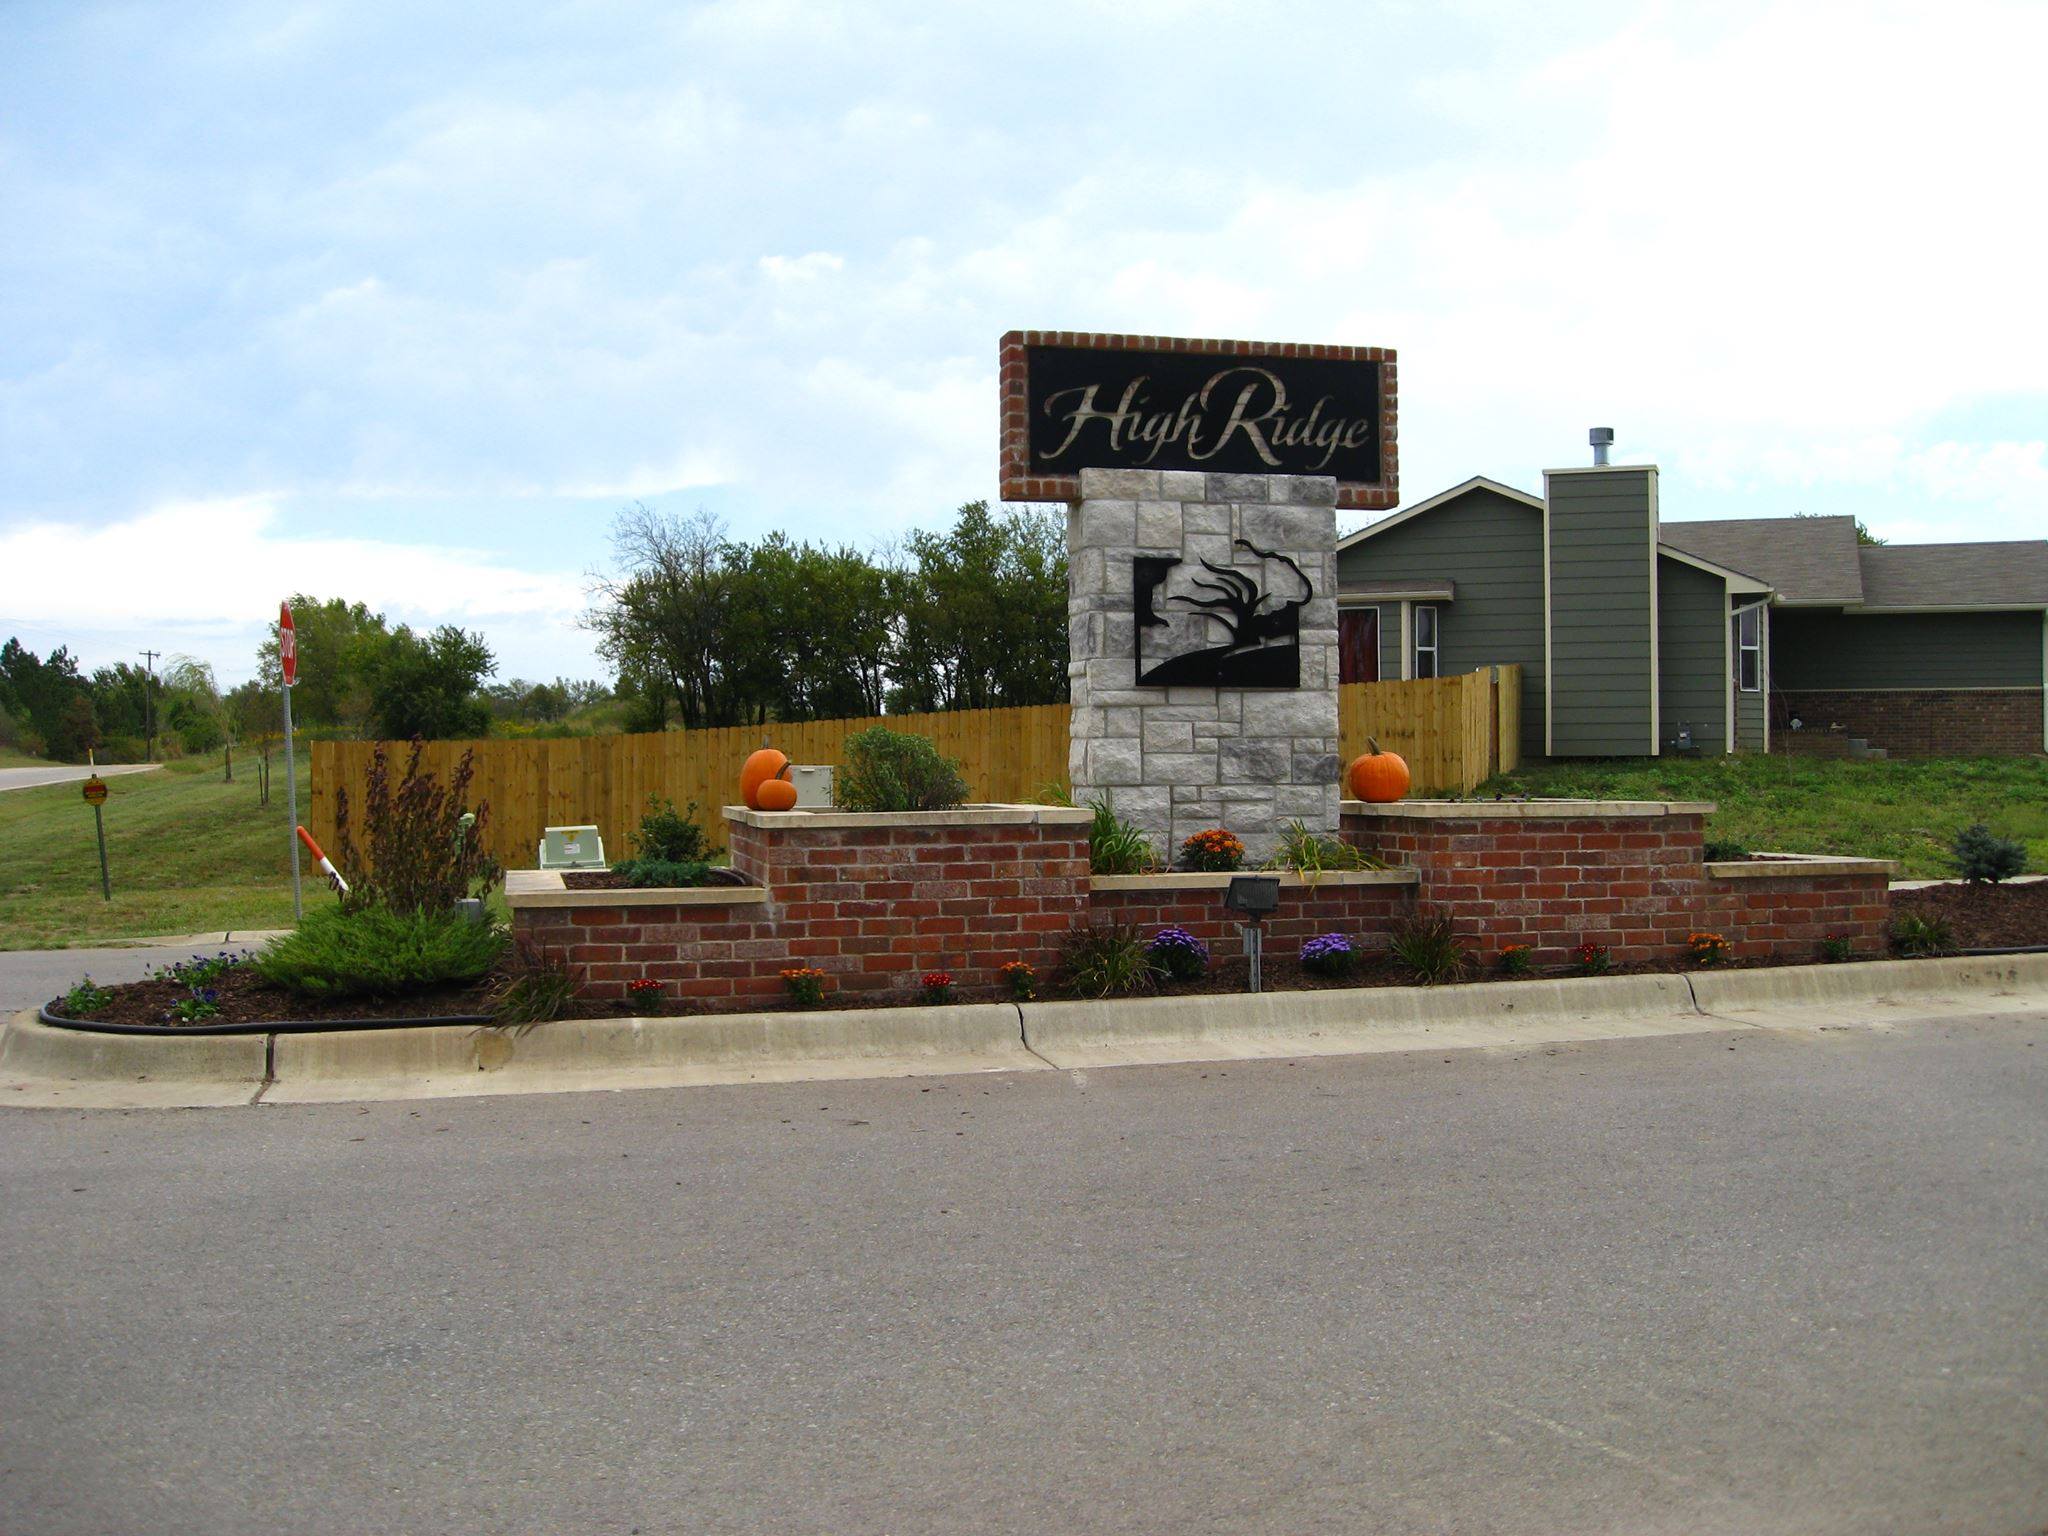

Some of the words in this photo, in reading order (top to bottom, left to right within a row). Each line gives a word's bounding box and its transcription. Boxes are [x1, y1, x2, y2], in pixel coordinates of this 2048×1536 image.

[1039, 376, 1204, 465] High
[1188, 367, 1369, 470] Ridge
[280, 627, 295, 659] STOP
